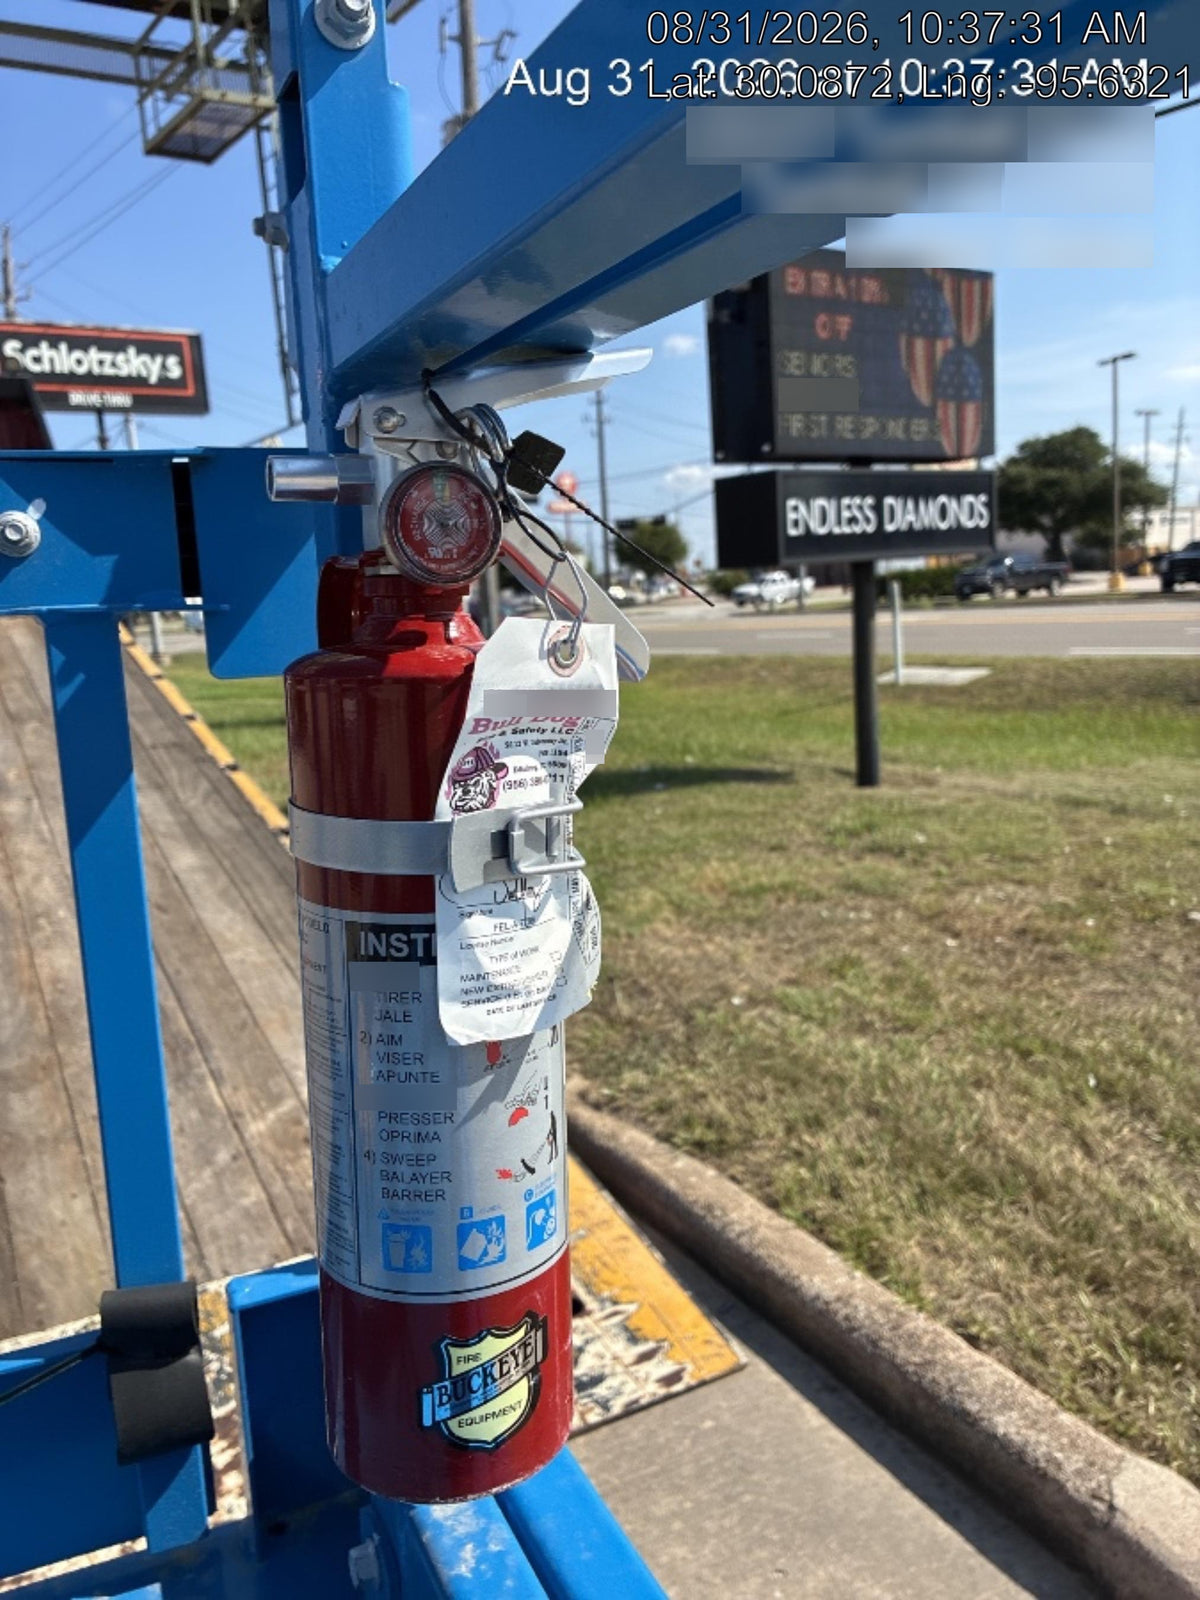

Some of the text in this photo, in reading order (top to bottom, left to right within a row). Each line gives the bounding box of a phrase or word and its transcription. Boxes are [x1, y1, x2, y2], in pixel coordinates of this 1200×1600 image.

[785, 493, 990, 536] ENDLESS DIAMONDS
[359, 930, 436, 958] INST
[374, 1009, 413, 1023] JALE
[376, 1033, 403, 1046] AIM
[376, 1052, 424, 1066] VISER
[376, 1070, 441, 1084] APUNTE
[378, 1110, 454, 1126] PRESSER
[379, 1129, 442, 1144] OPRIMA
[380, 1152, 437, 1167] SWEEP
[380, 1169, 452, 1184] BALAYER
[381, 1187, 446, 1202] BARRER
[456, 1352, 482, 1366] FIRE
[436, 1336, 535, 1409] BUCKEYE
[457, 1399, 523, 1429] EQUIPMENT
